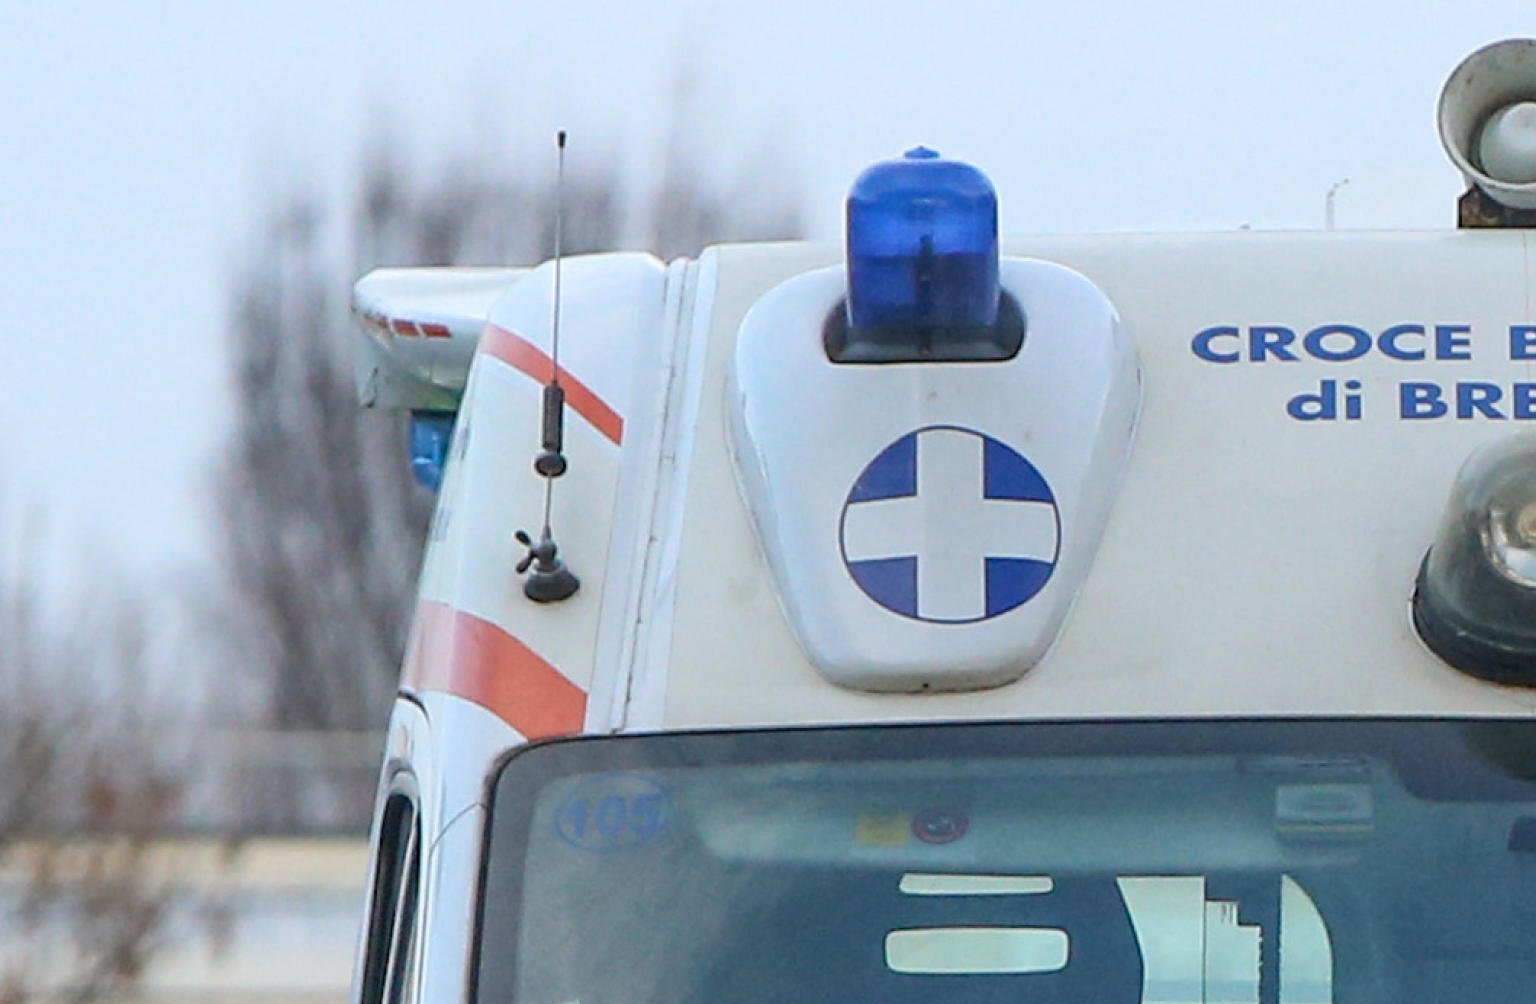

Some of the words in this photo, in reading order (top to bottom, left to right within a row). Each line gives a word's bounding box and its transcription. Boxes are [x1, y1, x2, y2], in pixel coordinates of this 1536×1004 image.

[1192, 323, 1472, 363] CROCE
[1287, 378, 1364, 420] di
[567, 793, 664, 838] 105
